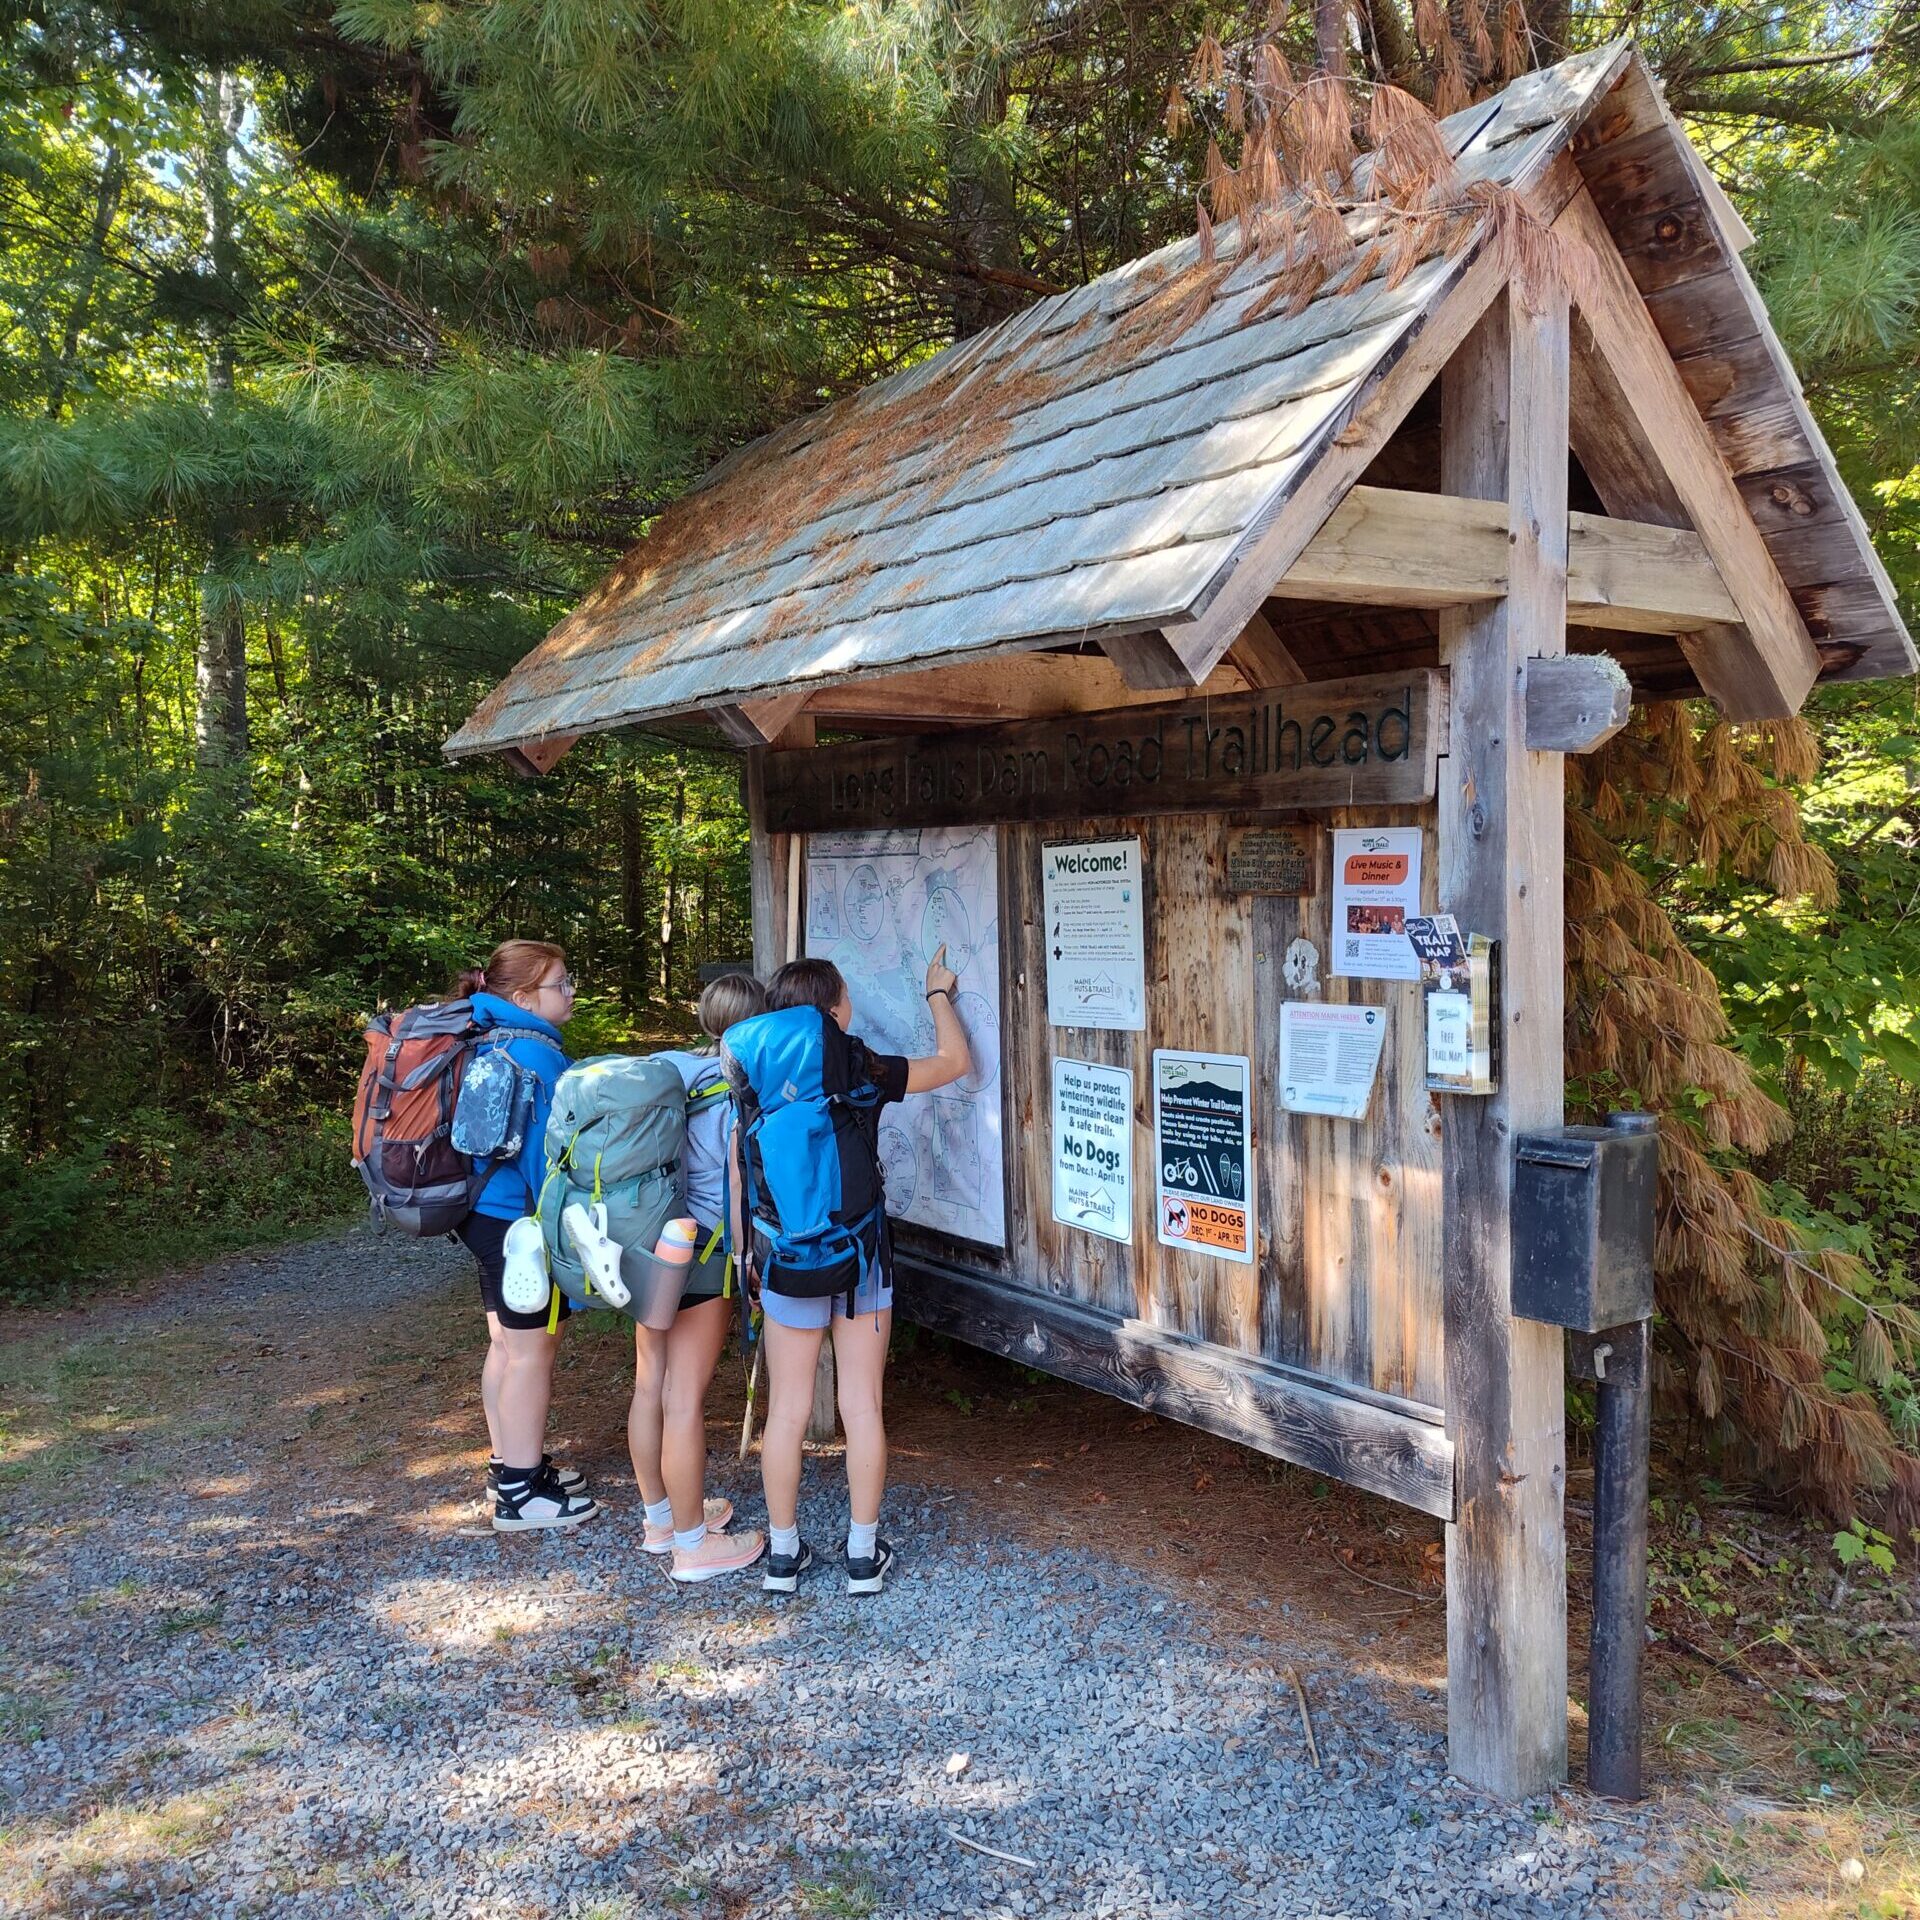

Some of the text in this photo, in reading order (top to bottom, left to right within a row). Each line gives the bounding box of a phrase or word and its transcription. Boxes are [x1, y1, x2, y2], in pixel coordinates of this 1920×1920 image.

[830, 685, 1412, 818] Long Falls Dam Road Trailhead
[1054, 849, 1128, 874] Welcome!
[1350, 860, 1402, 869] Live Music &
[1361, 872, 1391, 881] Dinner
[1415, 934, 1452, 946] TRAIL
[1425, 947, 1451, 957] MAP
[1289, 1010, 1320, 1019] ATTENTION
[1064, 1073, 1121, 1096] Help us protect
[1059, 1087, 1126, 1111] wintering wildlife
[1161, 1093, 1242, 1115] Help Prevent Winter Trail Damage
[1060, 1100, 1125, 1126] & maintain clean
[1069, 1116, 1115, 1137] & safe trails.
[1161, 1119, 1177, 1127] Please
[1177, 1121, 1188, 1129] limit
[1189, 1123, 1209, 1133] damage
[1226, 1129, 1242, 1137] winter
[1174, 1129, 1181, 1138] by
[1182, 1131, 1196, 1141] using
[1063, 1133, 1120, 1171] No Dogs
[1059, 1158, 1075, 1172] from
[1097, 1169, 1116, 1183] April
[1116, 1174, 1125, 1185] 15
[1068, 1187, 1089, 1199] MAINE
[1163, 1188, 1244, 1209] PLEASE RESPECT OUR LAND OWNERS
[1190, 1206, 1244, 1228] NO DOGS
[1191, 1225, 1204, 1237] DEC.
[1217, 1231, 1232, 1243] APR.
